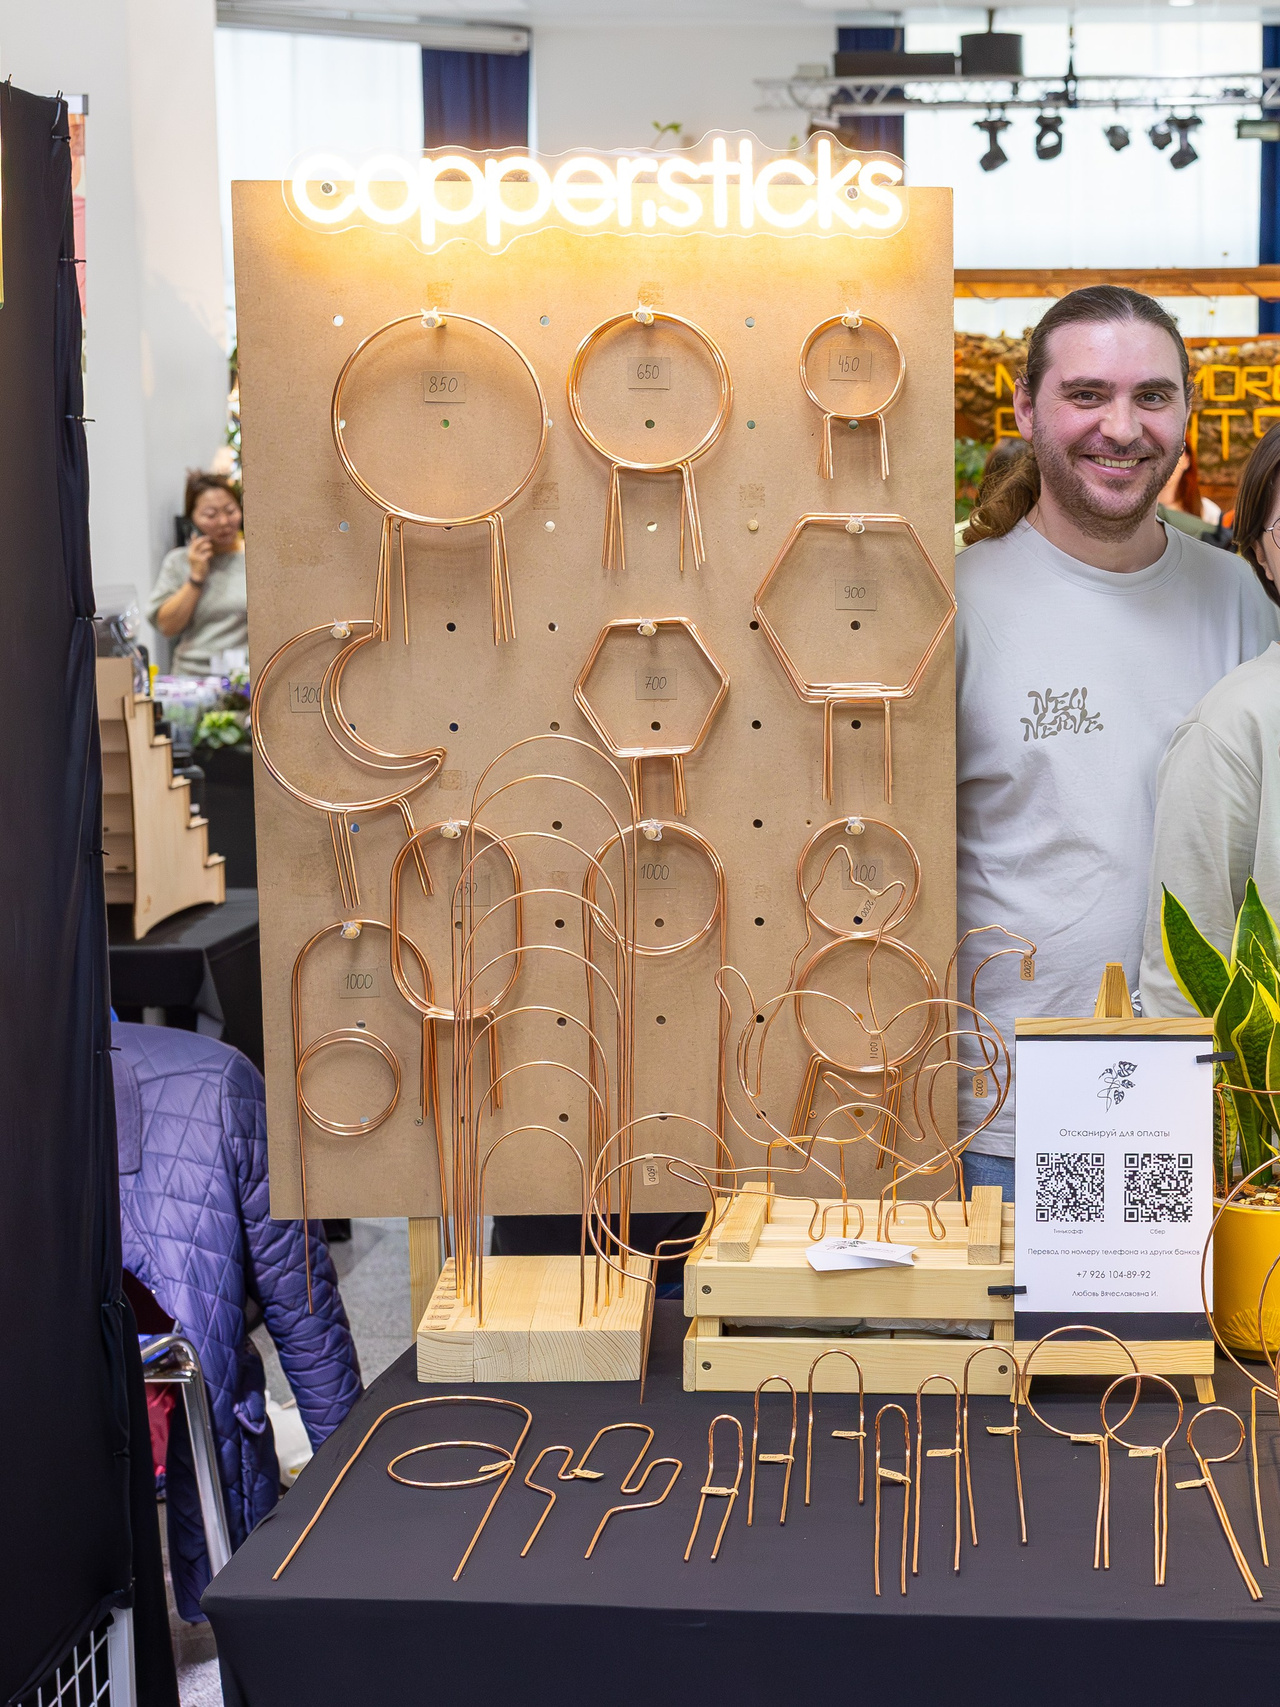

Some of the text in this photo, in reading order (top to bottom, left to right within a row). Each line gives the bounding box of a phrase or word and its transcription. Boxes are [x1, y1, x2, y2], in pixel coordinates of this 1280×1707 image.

[637, 363, 660, 380] 650
[838, 356, 860, 373] 450
[428, 376, 458, 393] 850
[844, 586, 867, 599] 900
[645, 676, 667, 690] 700
[1027, 687, 1088, 715] NEW
[1020, 710, 1104, 742] NERVE
[641, 864, 669, 881] 1000
[344, 973, 373, 990] 1000
[975, 1078, 984, 1097] 2000
[1059, 1128, 1170, 1139] Отсканируй для оплаты
[1027, 1248, 1059, 1256] Перевод
[1076, 1270, 1151, 1279] +7 926 104-89-92
